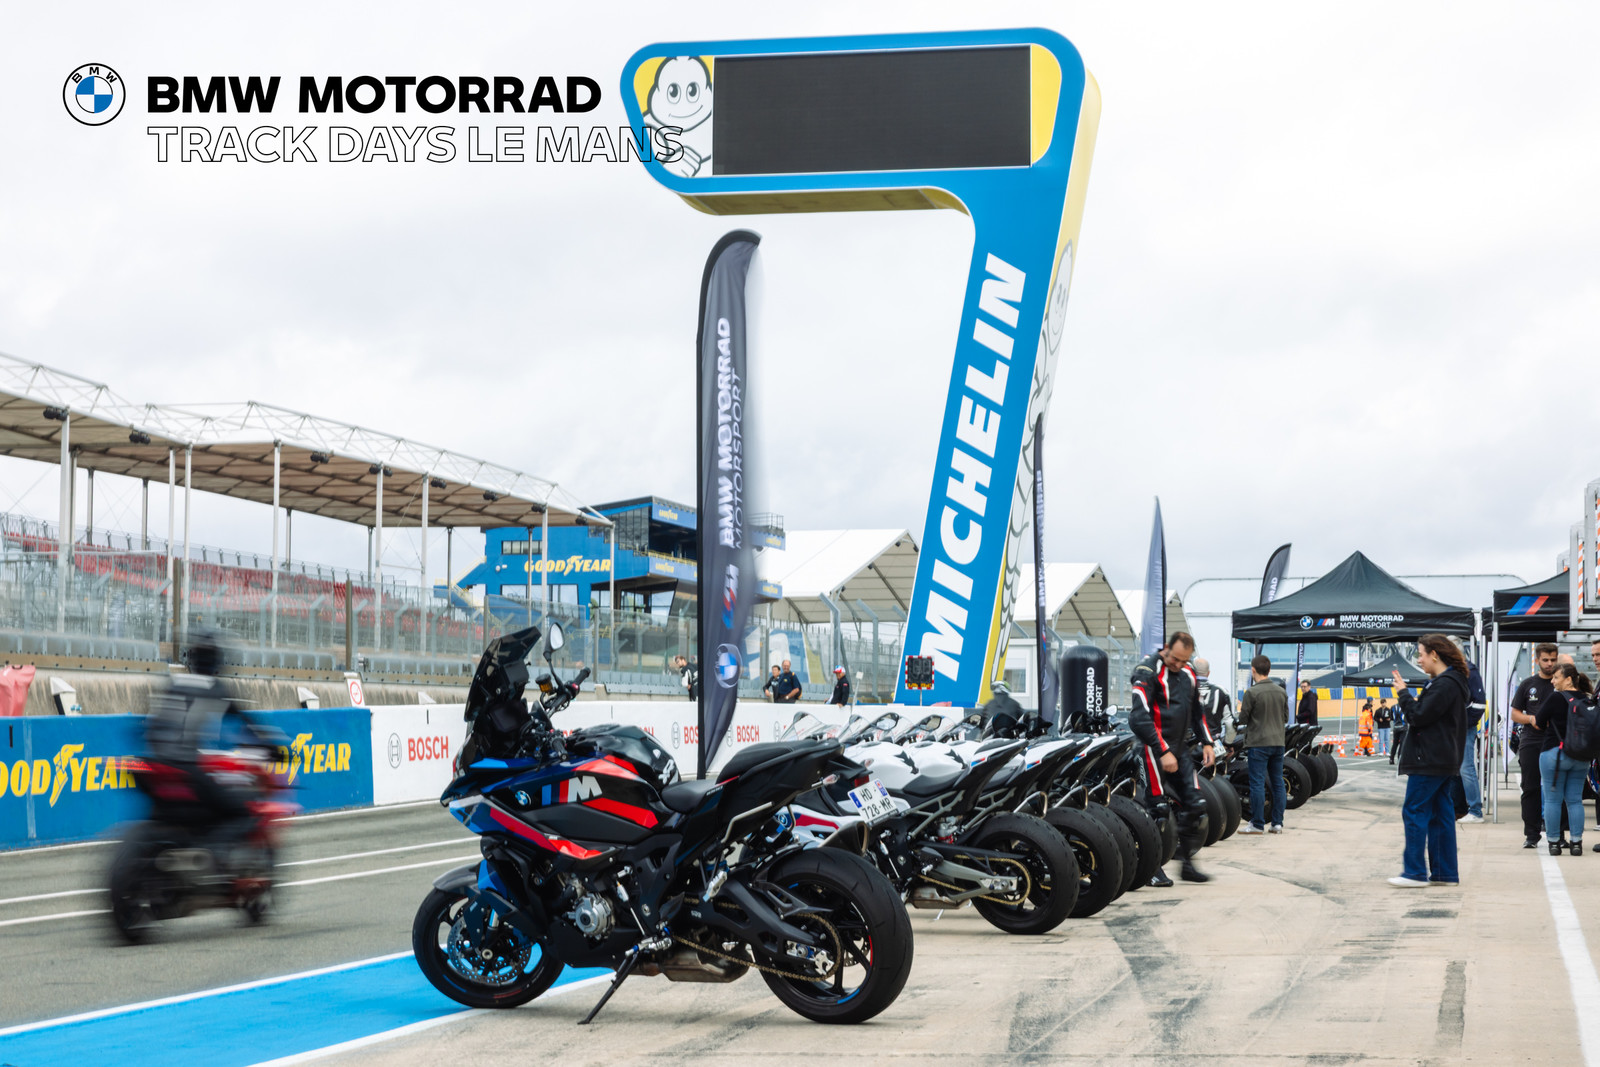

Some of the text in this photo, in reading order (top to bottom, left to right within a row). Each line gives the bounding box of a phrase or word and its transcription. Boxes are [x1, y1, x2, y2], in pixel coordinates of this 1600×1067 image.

[717, 317, 735, 549] BMW MOTORRAD
[730, 367, 744, 549] MOTORSPORT
[918, 252, 1027, 682] MICHELIN
[523, 559, 611, 573] GOODYEAR
[1087, 667, 1095, 717] OTORRAD
[684, 726, 699, 744] BOS
[736, 725, 760, 743] BOSCH
[408, 735, 449, 761] BOSCH
[0, 756, 136, 798] ODYEAR
[567, 776, 603, 803] M
[861, 797, 894, 819] 728-MR
